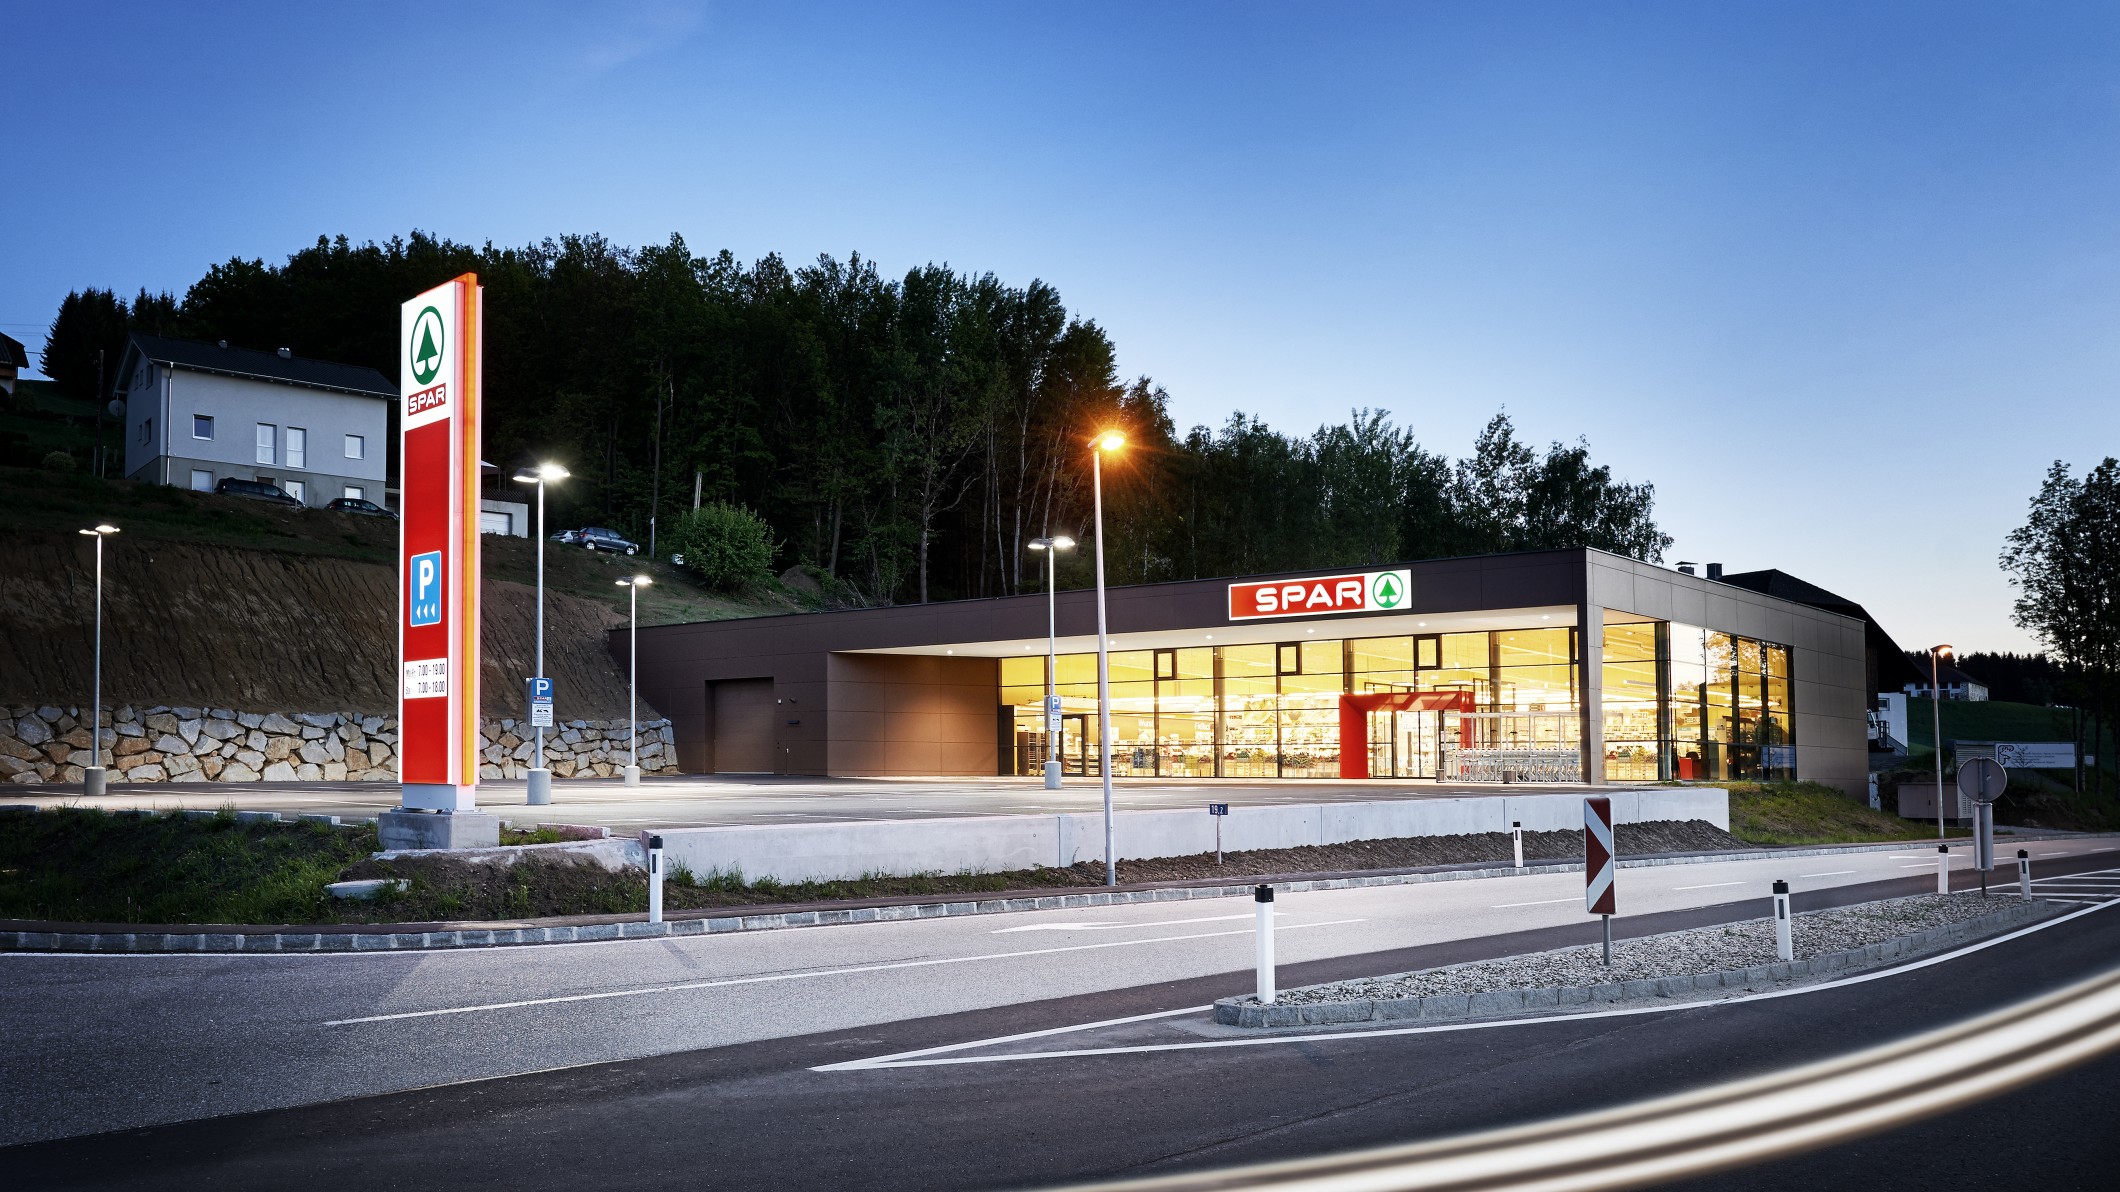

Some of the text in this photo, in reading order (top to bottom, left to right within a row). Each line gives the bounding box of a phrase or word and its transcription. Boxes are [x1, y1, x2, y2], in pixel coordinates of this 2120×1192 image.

[410, 387, 445, 413] SPAR
[420, 559, 434, 600] P
[1256, 581, 1362, 612] SPAR
[432, 681, 445, 692] 18.00
[537, 680, 549, 695] P
[1052, 697, 1059, 708] P
